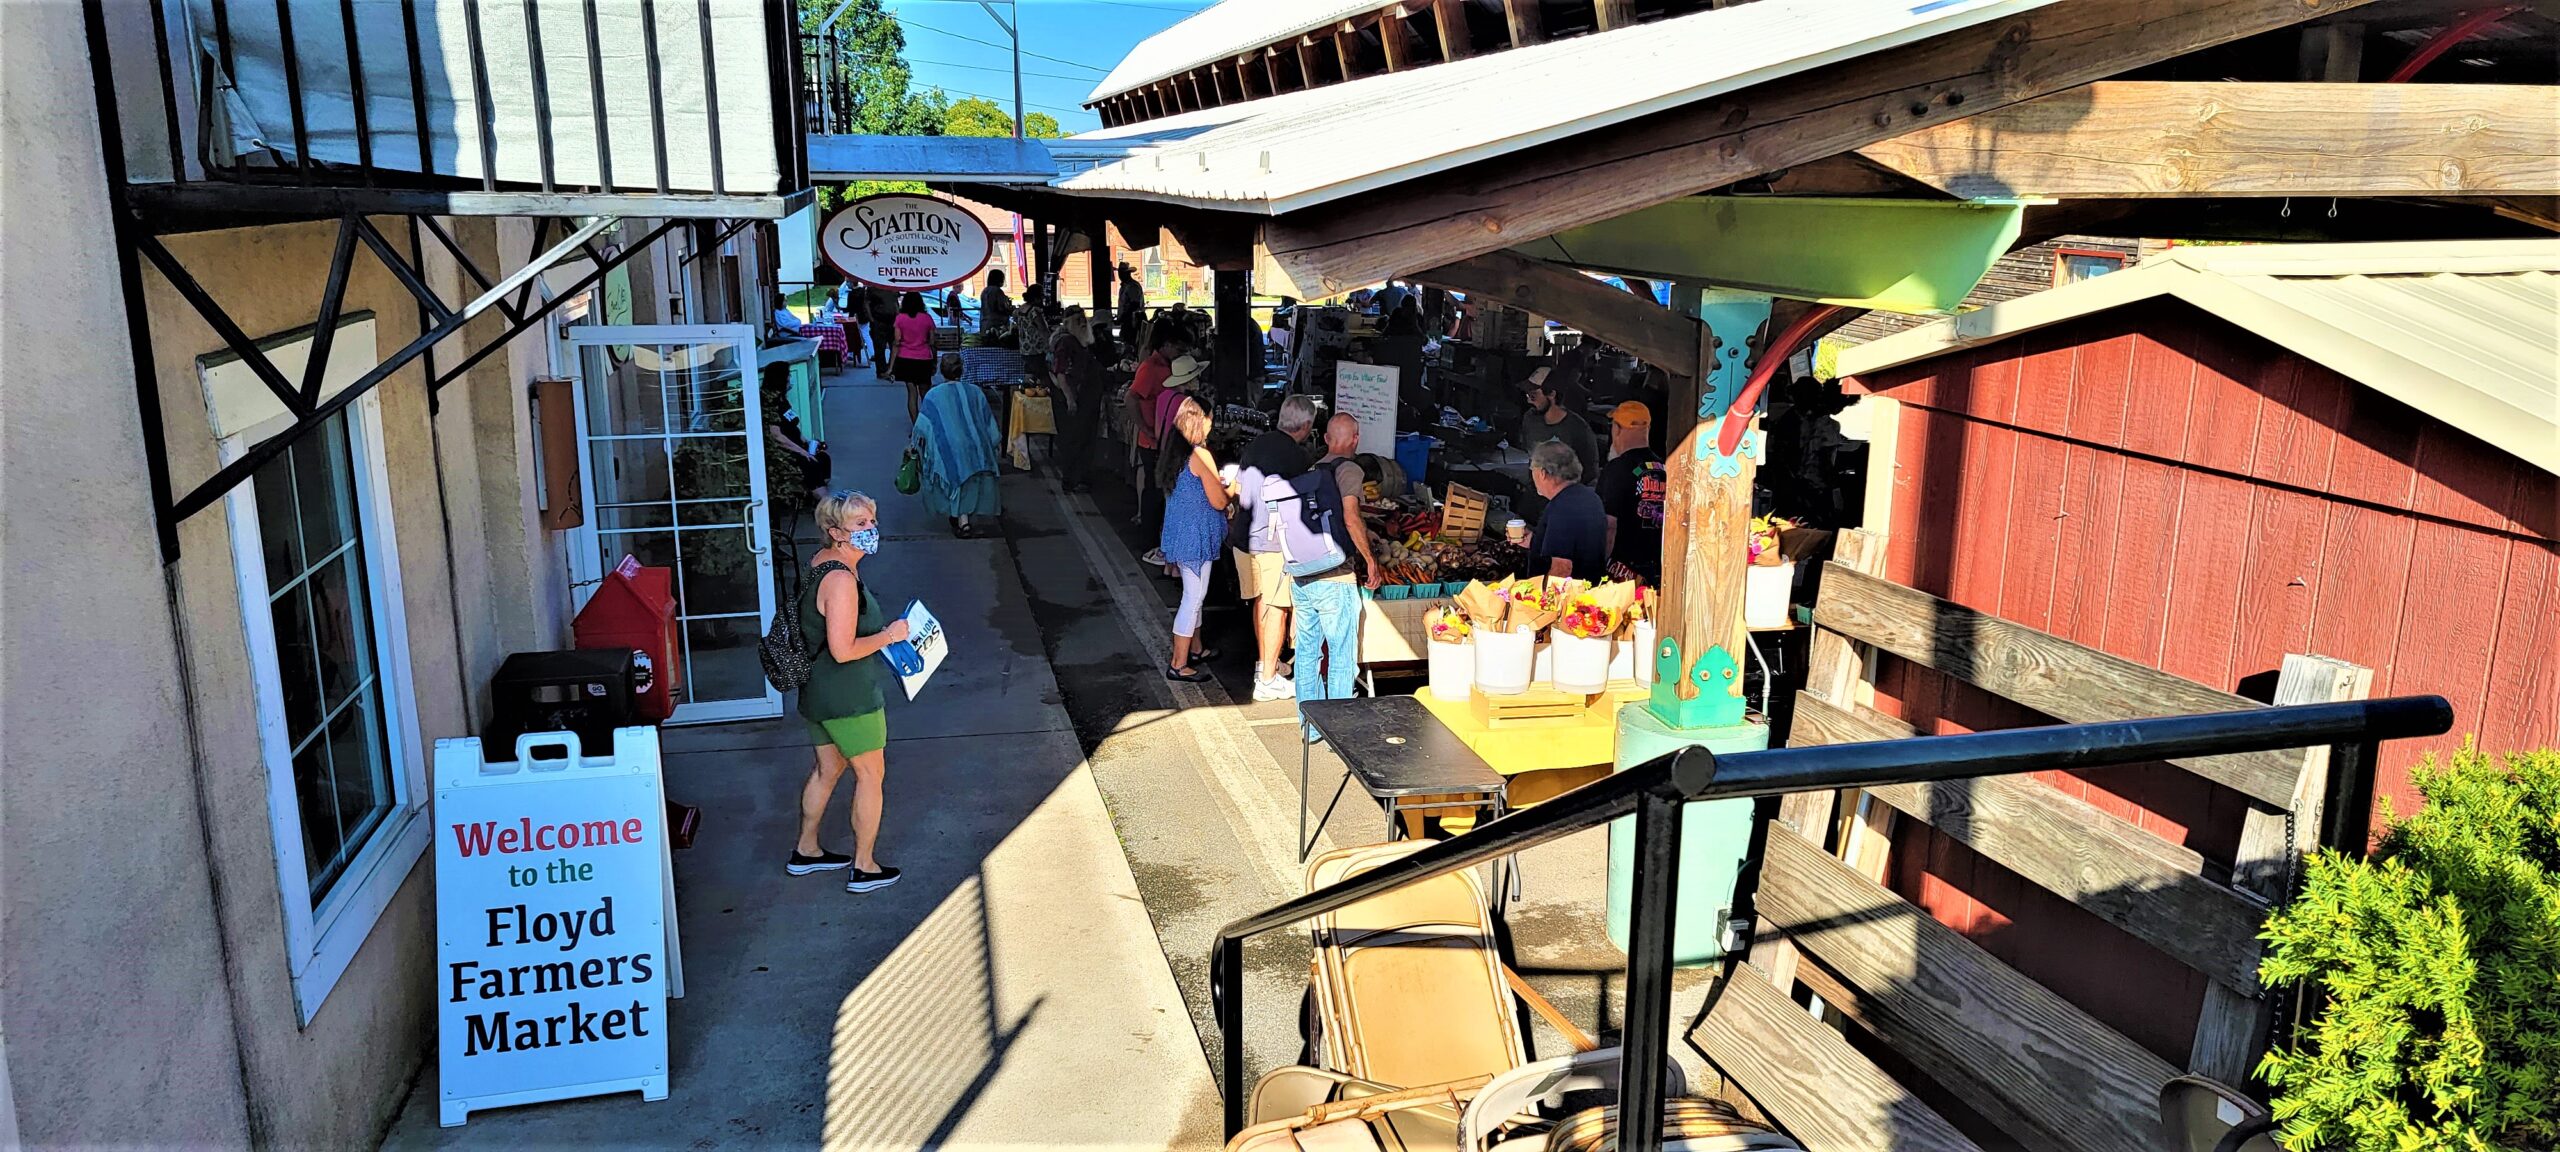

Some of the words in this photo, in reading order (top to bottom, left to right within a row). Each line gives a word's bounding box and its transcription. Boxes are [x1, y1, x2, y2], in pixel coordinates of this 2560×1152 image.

[840, 205, 962, 250] STATION
[884, 236, 895, 246] ON
[895, 232, 921, 241] SOUTH
[921, 234, 950, 247] LOCUST
[890, 245, 938, 255] GALLERIES
[940, 246, 949, 256] &
[890, 256, 921, 265] SHOPS
[877, 266, 939, 278] ENTRANCE
[919, 617, 935, 638] LION
[451, 816, 644, 859] Welcome
[508, 863, 538, 888] to
[546, 857, 594, 884] the
[485, 896, 616, 951] Floyd
[449, 952, 653, 1003] Farmers
[463, 999, 649, 1057] Market
